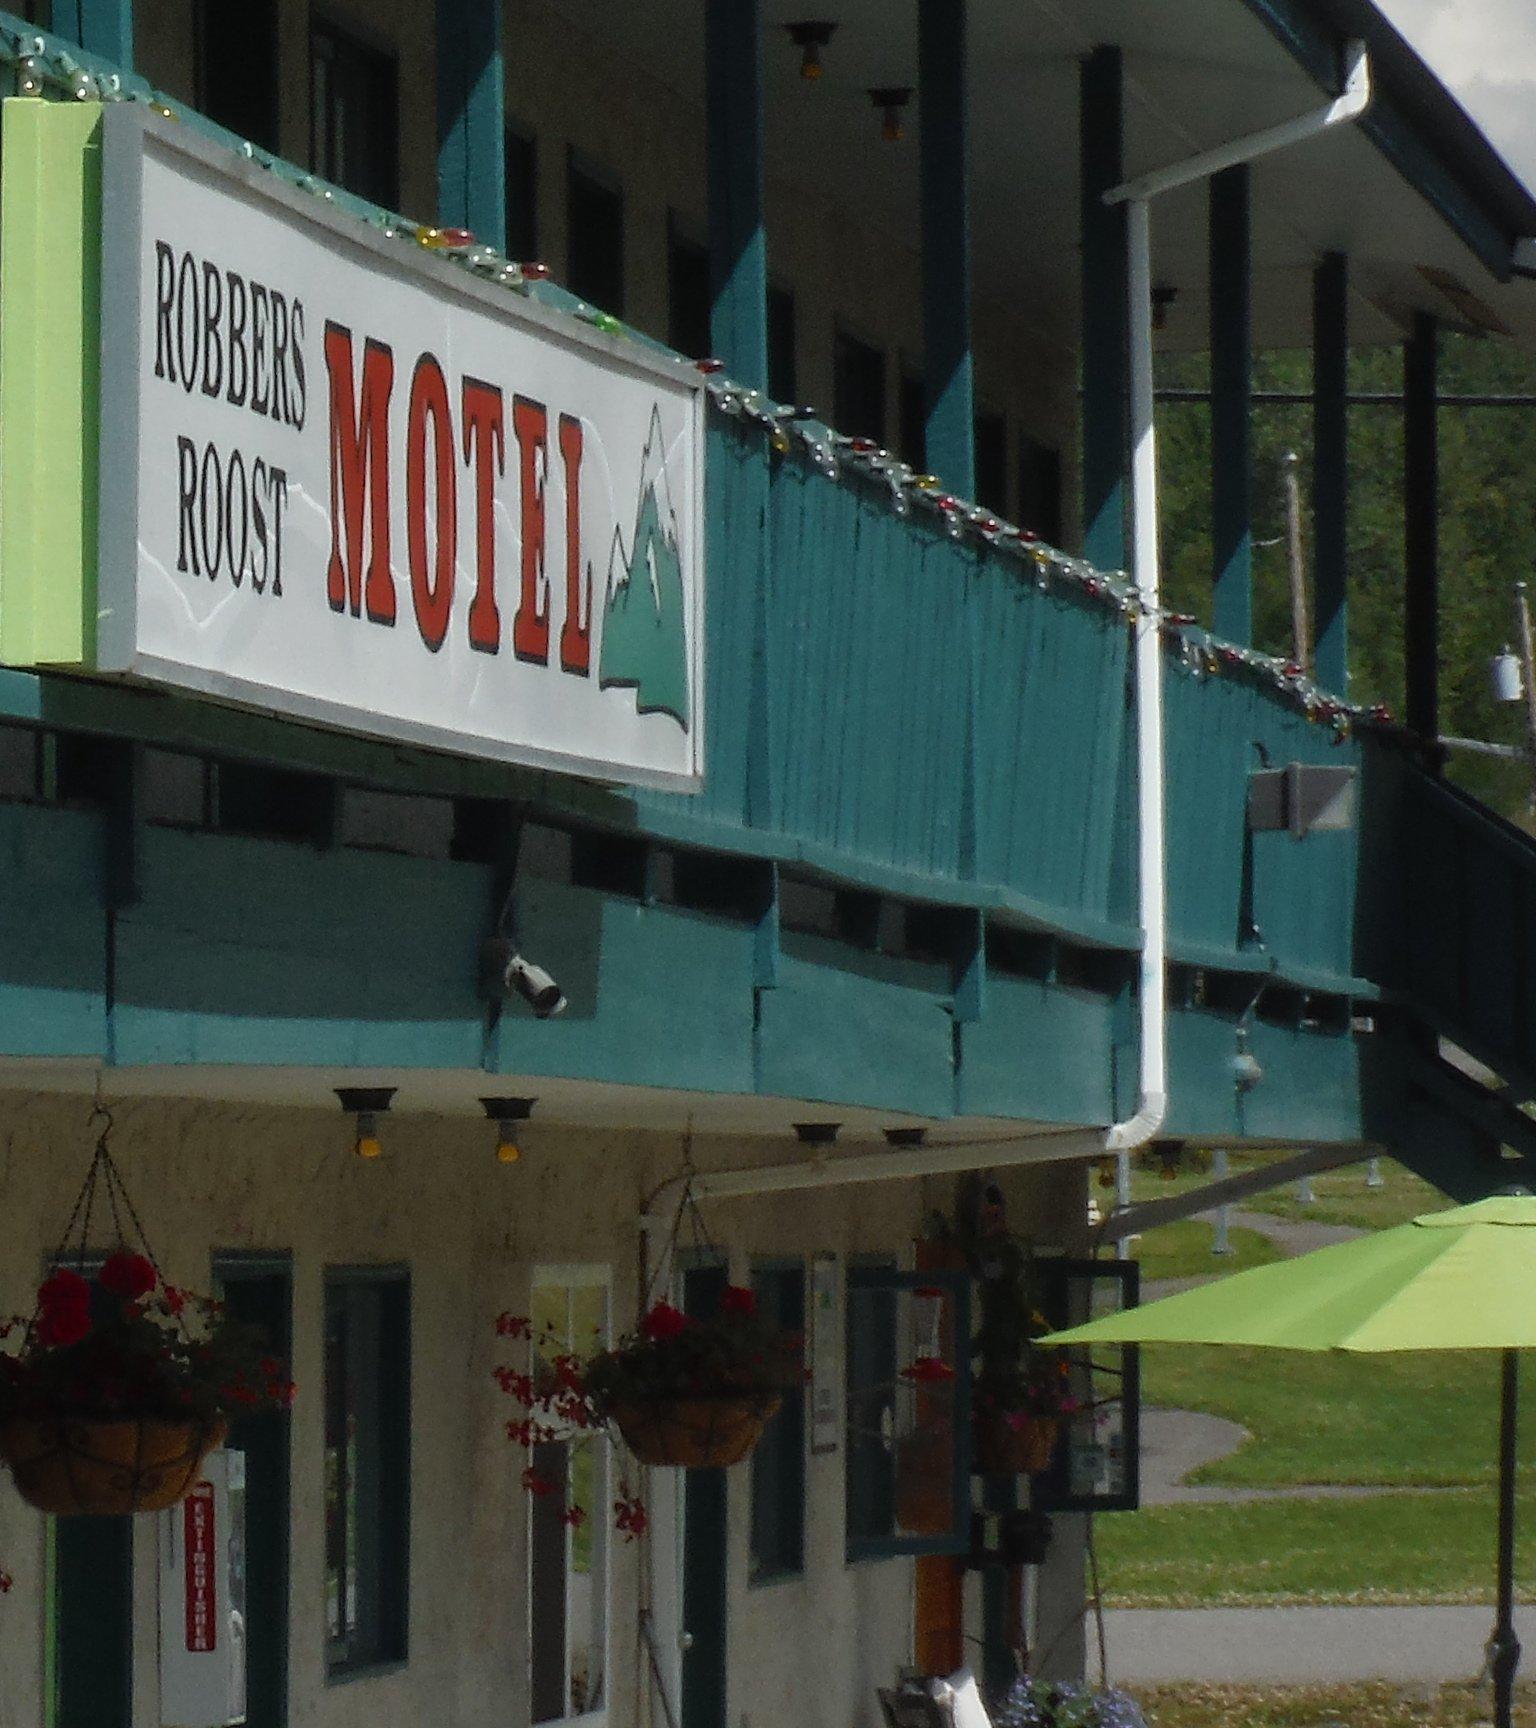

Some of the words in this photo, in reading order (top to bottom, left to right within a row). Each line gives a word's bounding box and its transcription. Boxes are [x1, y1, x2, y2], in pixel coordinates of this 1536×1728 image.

[154, 239, 307, 432] ROBBERS
[176, 435, 288, 597] ROOST
[324, 319, 593, 677] MOTEL
